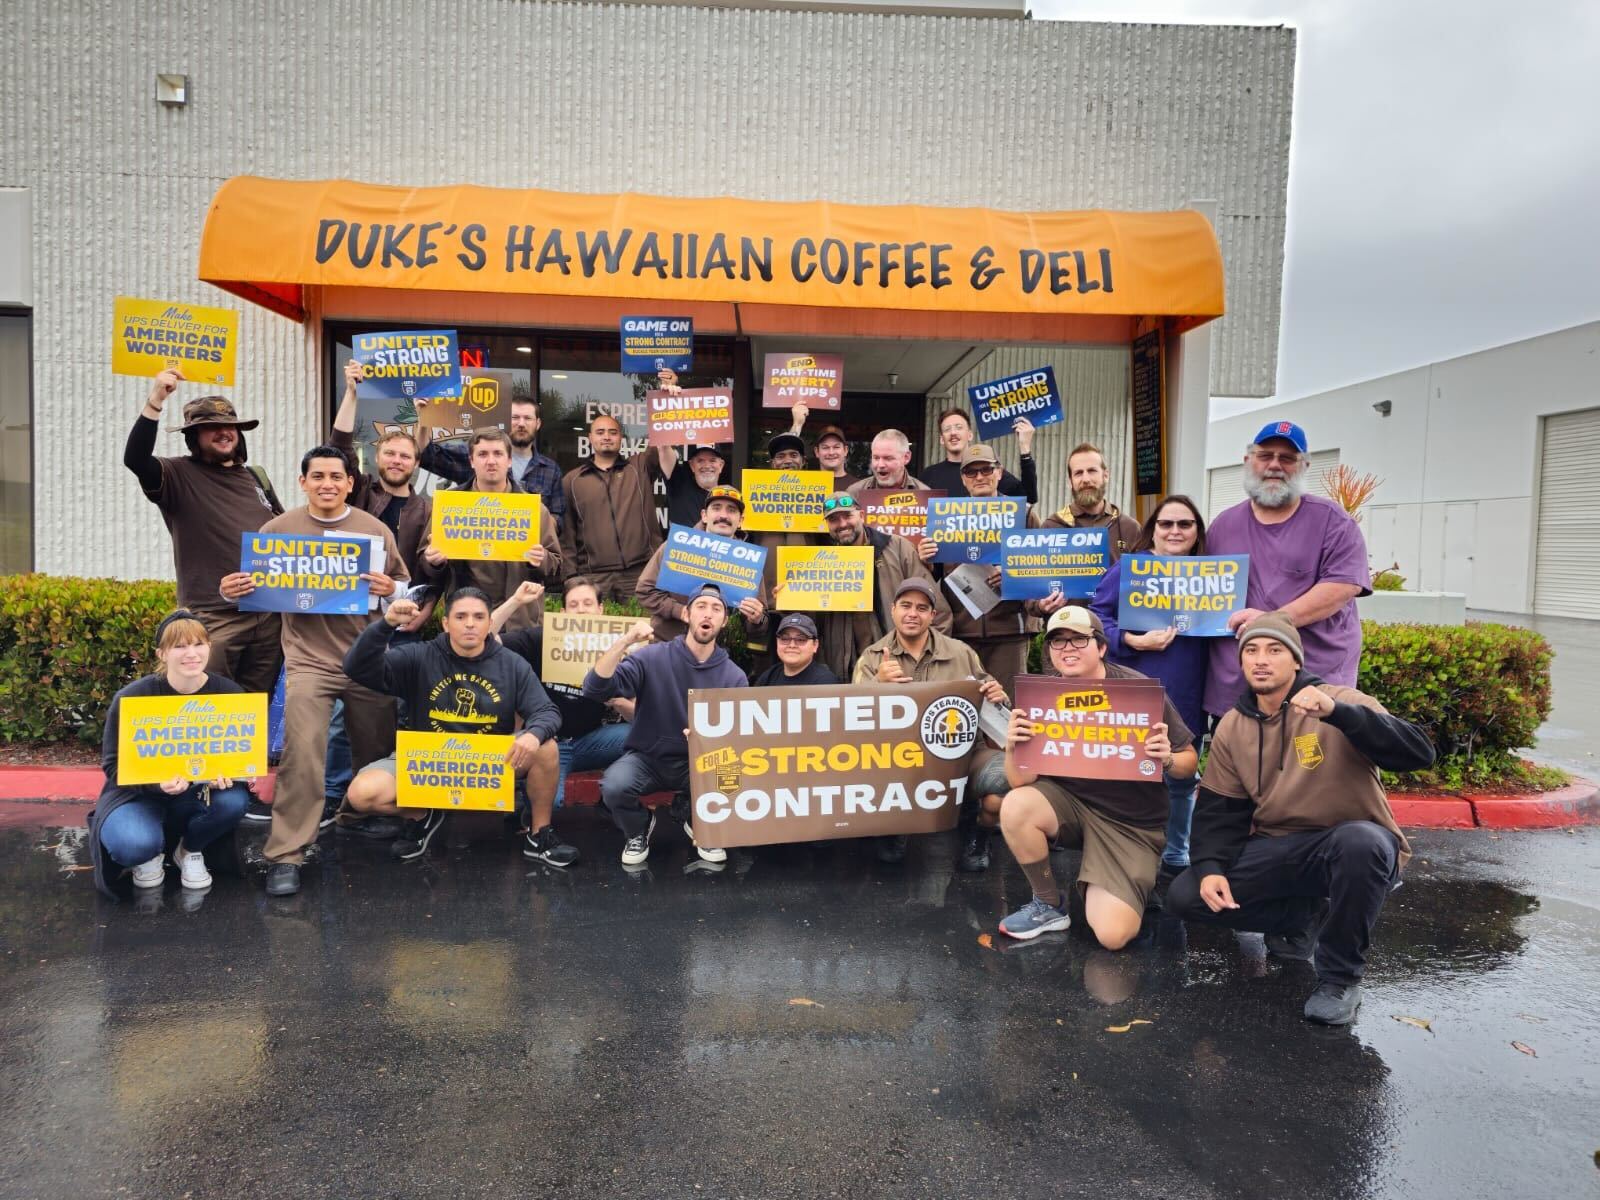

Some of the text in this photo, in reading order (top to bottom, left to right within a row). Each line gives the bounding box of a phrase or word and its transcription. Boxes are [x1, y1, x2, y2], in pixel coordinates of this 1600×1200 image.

[315, 219, 1114, 294] DUKE'S HAWAIIAN COFFEE & DELI
[161, 306, 192, 321] Make
[124, 315, 228, 334] UPS DELIVER FOR
[625, 321, 690, 332] GAME ON
[123, 326, 227, 348] AMERICAN
[360, 335, 450, 350] UNITED
[625, 337, 689, 346] STRONG CONTRACT
[126, 340, 222, 362] WORKERS
[375, 345, 449, 367] STRONG
[362, 364, 451, 378] CONTRACT
[792, 359, 812, 368] END
[772, 368, 836, 378] PART-TIME
[770, 377, 836, 388] POVERTY
[975, 372, 1048, 400] UNITED
[778, 387, 828, 398] AT UPS
[989, 382, 1049, 411] STRONG
[652, 395, 730, 411] UNITED
[981, 395, 1052, 423] CONTRACT
[585, 402, 647, 425] ESPRE
[666, 408, 729, 420] STRONG
[653, 419, 730, 431] CONTRACT
[777, 474, 800, 484] Make
[475, 496, 502, 507] Make
[750, 493, 825, 503] AMERICAN
[889, 496, 913, 505] END
[752, 503, 823, 514] WORKERS
[867, 505, 929, 514] PART-TIM
[935, 501, 1018, 515] UNITED
[441, 516, 531, 529] AMERICAN
[866, 515, 928, 525] POVERT
[946, 512, 1015, 532] STRONG
[444, 528, 528, 541] WORKERS
[877, 526, 927, 536] AT UPS
[933, 529, 1001, 544] CONTRAC
[252, 538, 361, 557] UNITED
[673, 531, 762, 562] GAME ON
[1006, 533, 1103, 548] GAME ON
[814, 550, 839, 560] Make
[1007, 553, 1104, 566] STRONG CONTRACT
[268, 555, 358, 576] STRONG
[669, 549, 758, 579] STRONG CONTRACT
[1131, 560, 1239, 577] UNITED
[252, 572, 360, 591] CONTRACT
[785, 569, 865, 580] AMERICAN
[788, 581, 863, 592] WORKERS
[1146, 573, 1235, 597] STRONG
[1129, 592, 1237, 612] CONTRACT
[455, 673, 467, 681] WE
[470, 674, 501, 703] BARGAIN
[179, 700, 215, 713] Make
[1064, 694, 1104, 709] END
[132, 713, 257, 726] UPS DELIVER FOR
[694, 694, 918, 738] UNITED
[924, 698, 977, 729] UPS TEAMSTERS
[1030, 707, 1149, 726] PART-TIME
[133, 724, 256, 742] AMERICAN
[925, 731, 975, 745] UNITED
[1030, 722, 1150, 743] POVERTY
[136, 739, 252, 758] WORKERS
[442, 739, 472, 750] Make
[1042, 741, 1136, 760] AT UPS
[406, 750, 505, 761] UPS DELIVER FOR
[703, 741, 924, 776] FOR A STRONG
[406, 760, 504, 775] AMERICAN
[410, 774, 501, 789] WORKERS
[695, 776, 969, 824] CONTRACT
